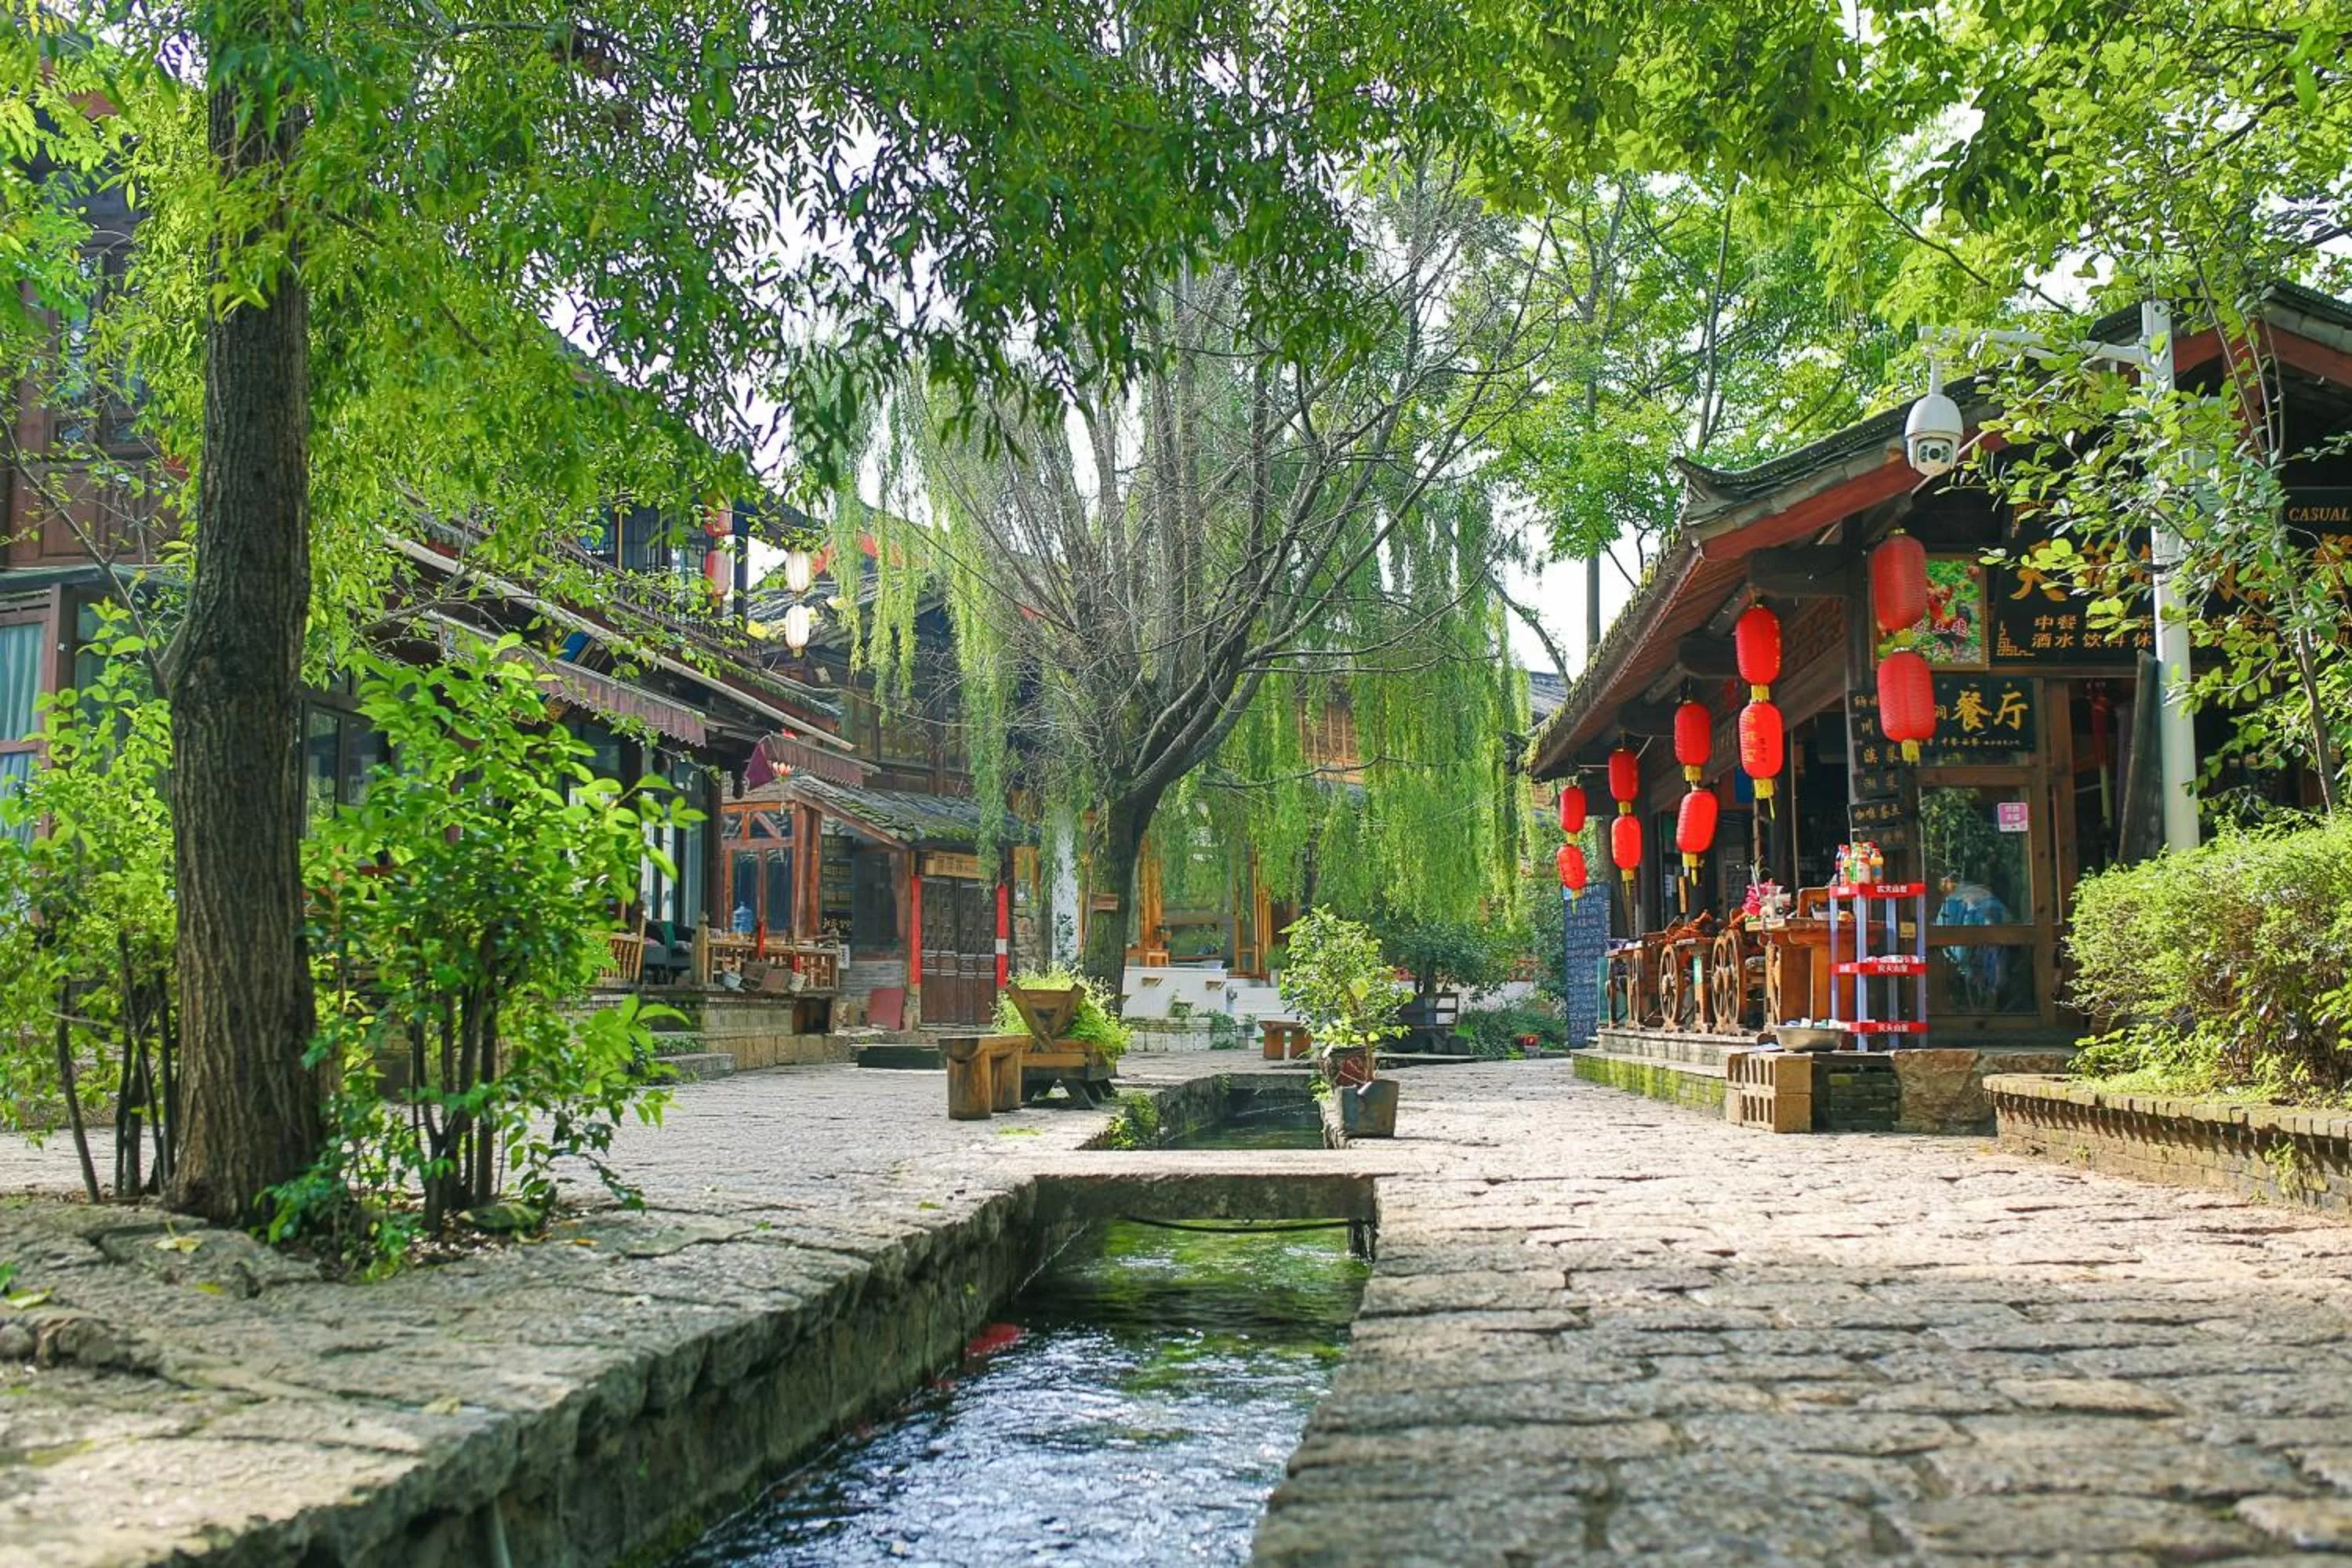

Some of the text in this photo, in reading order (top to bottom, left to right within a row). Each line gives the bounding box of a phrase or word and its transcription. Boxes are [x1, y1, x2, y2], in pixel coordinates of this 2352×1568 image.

[2288, 508, 2350, 521] CASUAL
[2034, 614, 2077, 630] 中餐
[2031, 633, 2074, 648] 酒水
[1951, 690, 2028, 731] 餐厅
